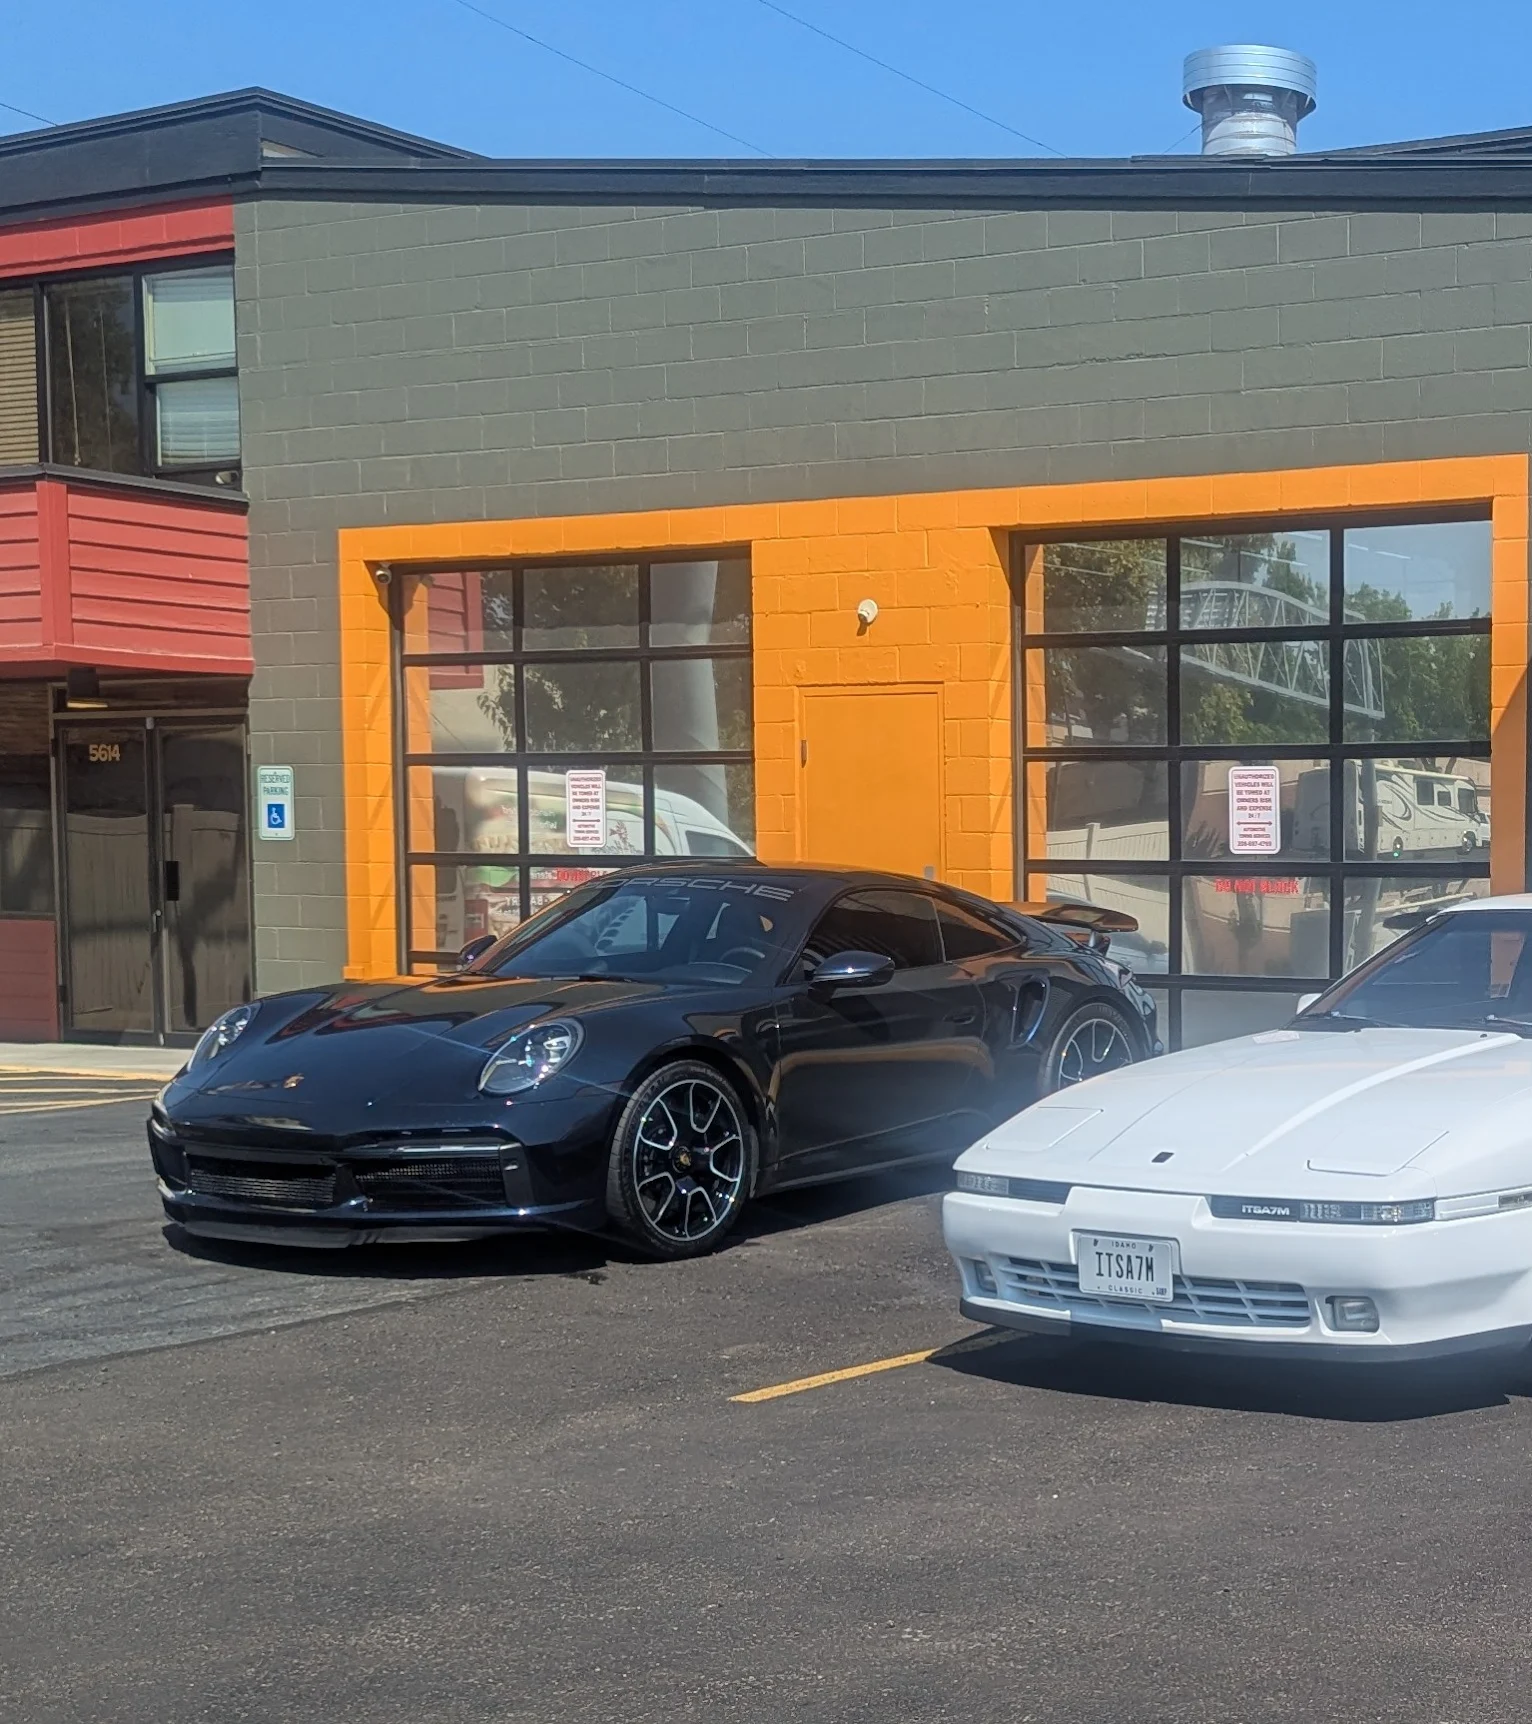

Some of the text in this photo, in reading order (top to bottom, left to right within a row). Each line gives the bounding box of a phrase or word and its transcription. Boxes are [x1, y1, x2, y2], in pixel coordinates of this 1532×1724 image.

[89, 744, 120, 761] 5614
[1241, 1204, 1290, 1216] ITSA7M
[1111, 1241, 1136, 1249] IDAHO
[1095, 1251, 1154, 1282] ITSA7M
[1108, 1284, 1143, 1294] CLASSIC
